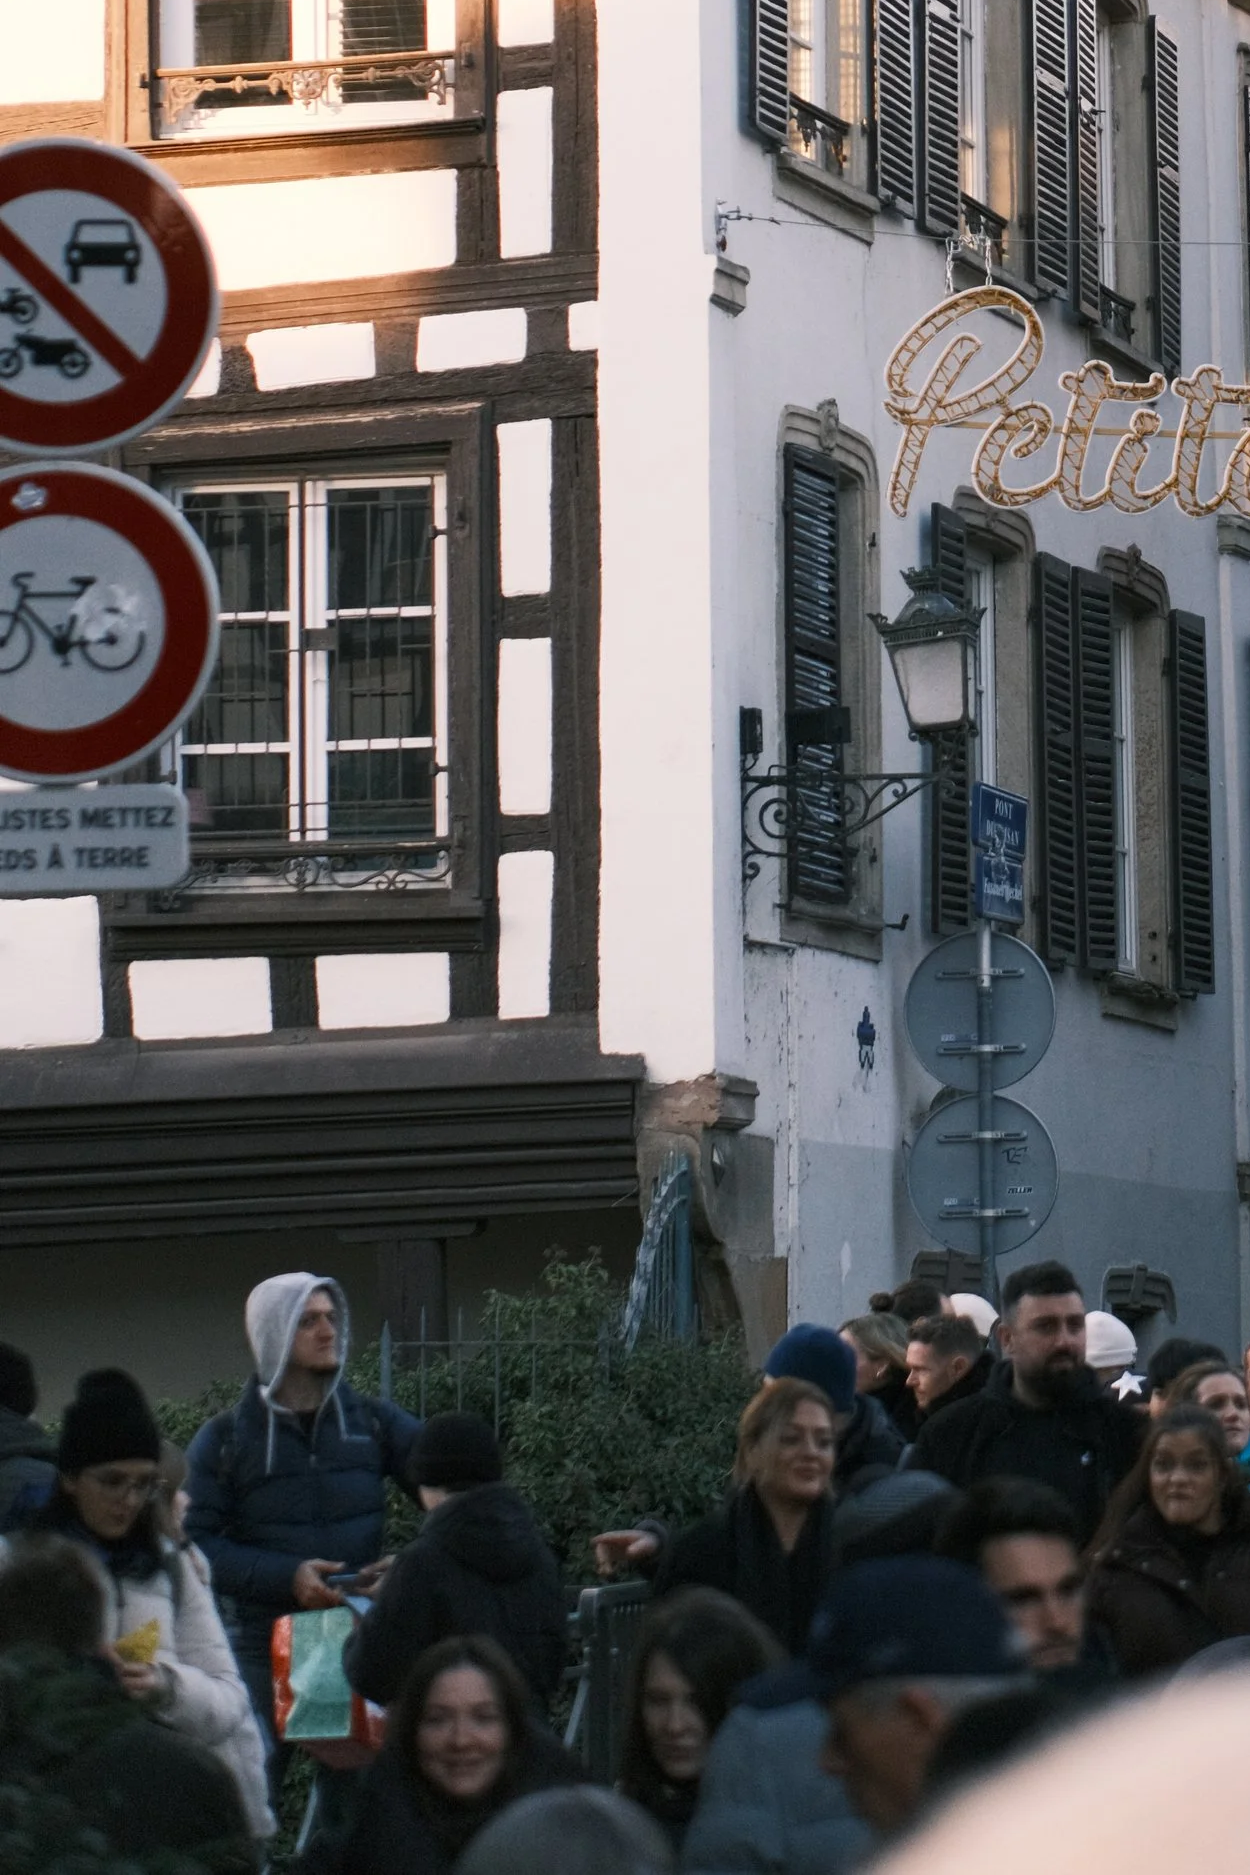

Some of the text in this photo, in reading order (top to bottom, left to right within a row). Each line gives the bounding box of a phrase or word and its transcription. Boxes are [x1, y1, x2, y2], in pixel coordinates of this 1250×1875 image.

[0, 805, 177, 830] ISTES METTEZ
[994, 798, 1014, 820] PONT
[73, 846, 149, 869] TERRE
